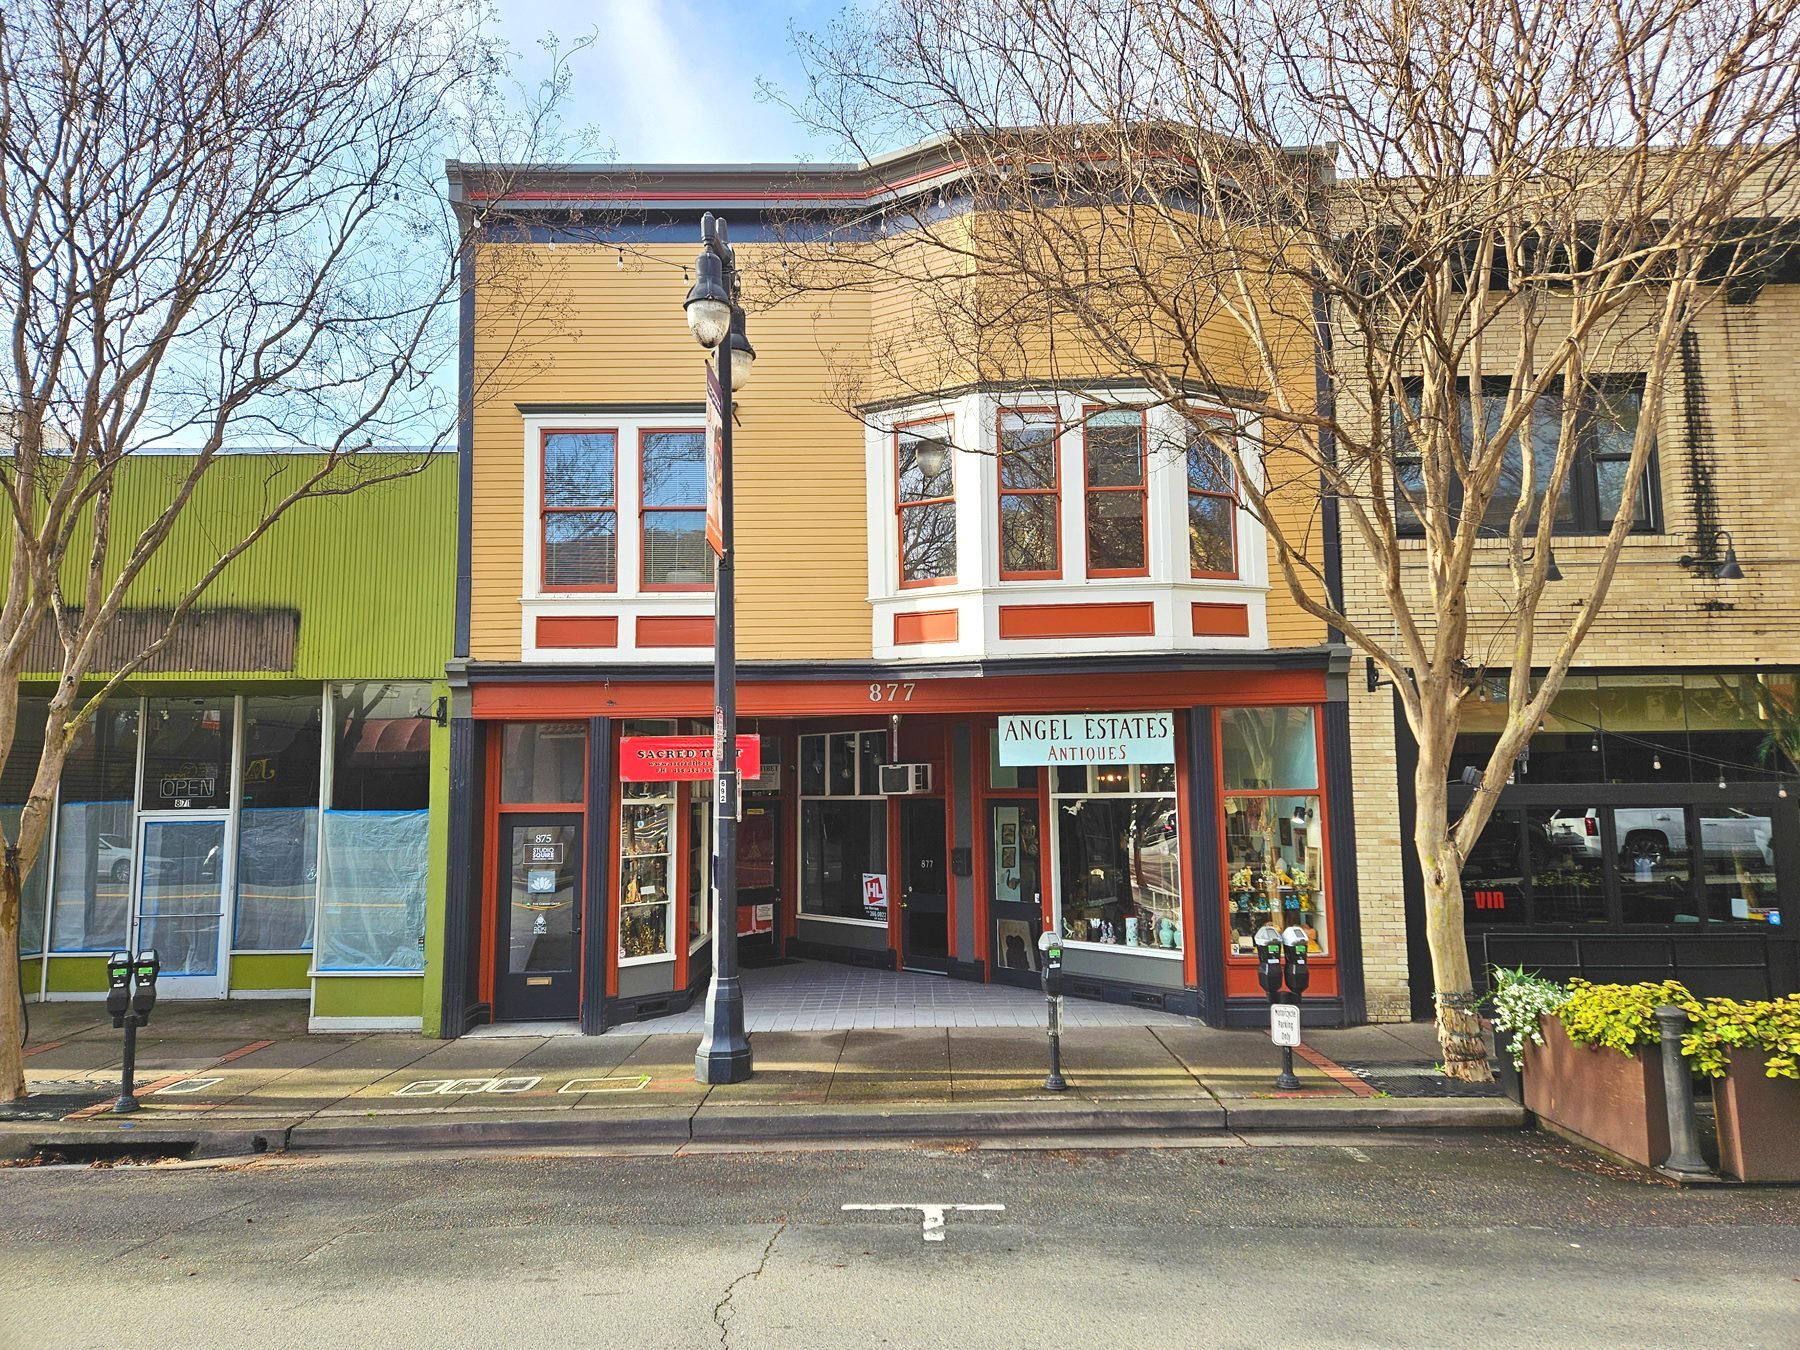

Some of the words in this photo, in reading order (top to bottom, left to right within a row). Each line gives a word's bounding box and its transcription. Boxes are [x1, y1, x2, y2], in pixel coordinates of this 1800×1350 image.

[869, 683, 916, 702] 877
[1005, 719, 1073, 741] ANGEL
[1085, 717, 1168, 740] ESTATES
[637, 749, 696, 759] SACRED
[1048, 744, 1126, 762] ANTIQUES
[162, 780, 213, 796] OPEN
[175, 799, 191, 807] 871
[535, 834, 552, 843] 875
[921, 859, 934, 869] 877
[867, 882, 884, 898] HL
[1275, 1009, 1296, 1018] Motorcycle
[1278, 1020, 1294, 1031] Parking
[1281, 1032, 1291, 1042] Only
